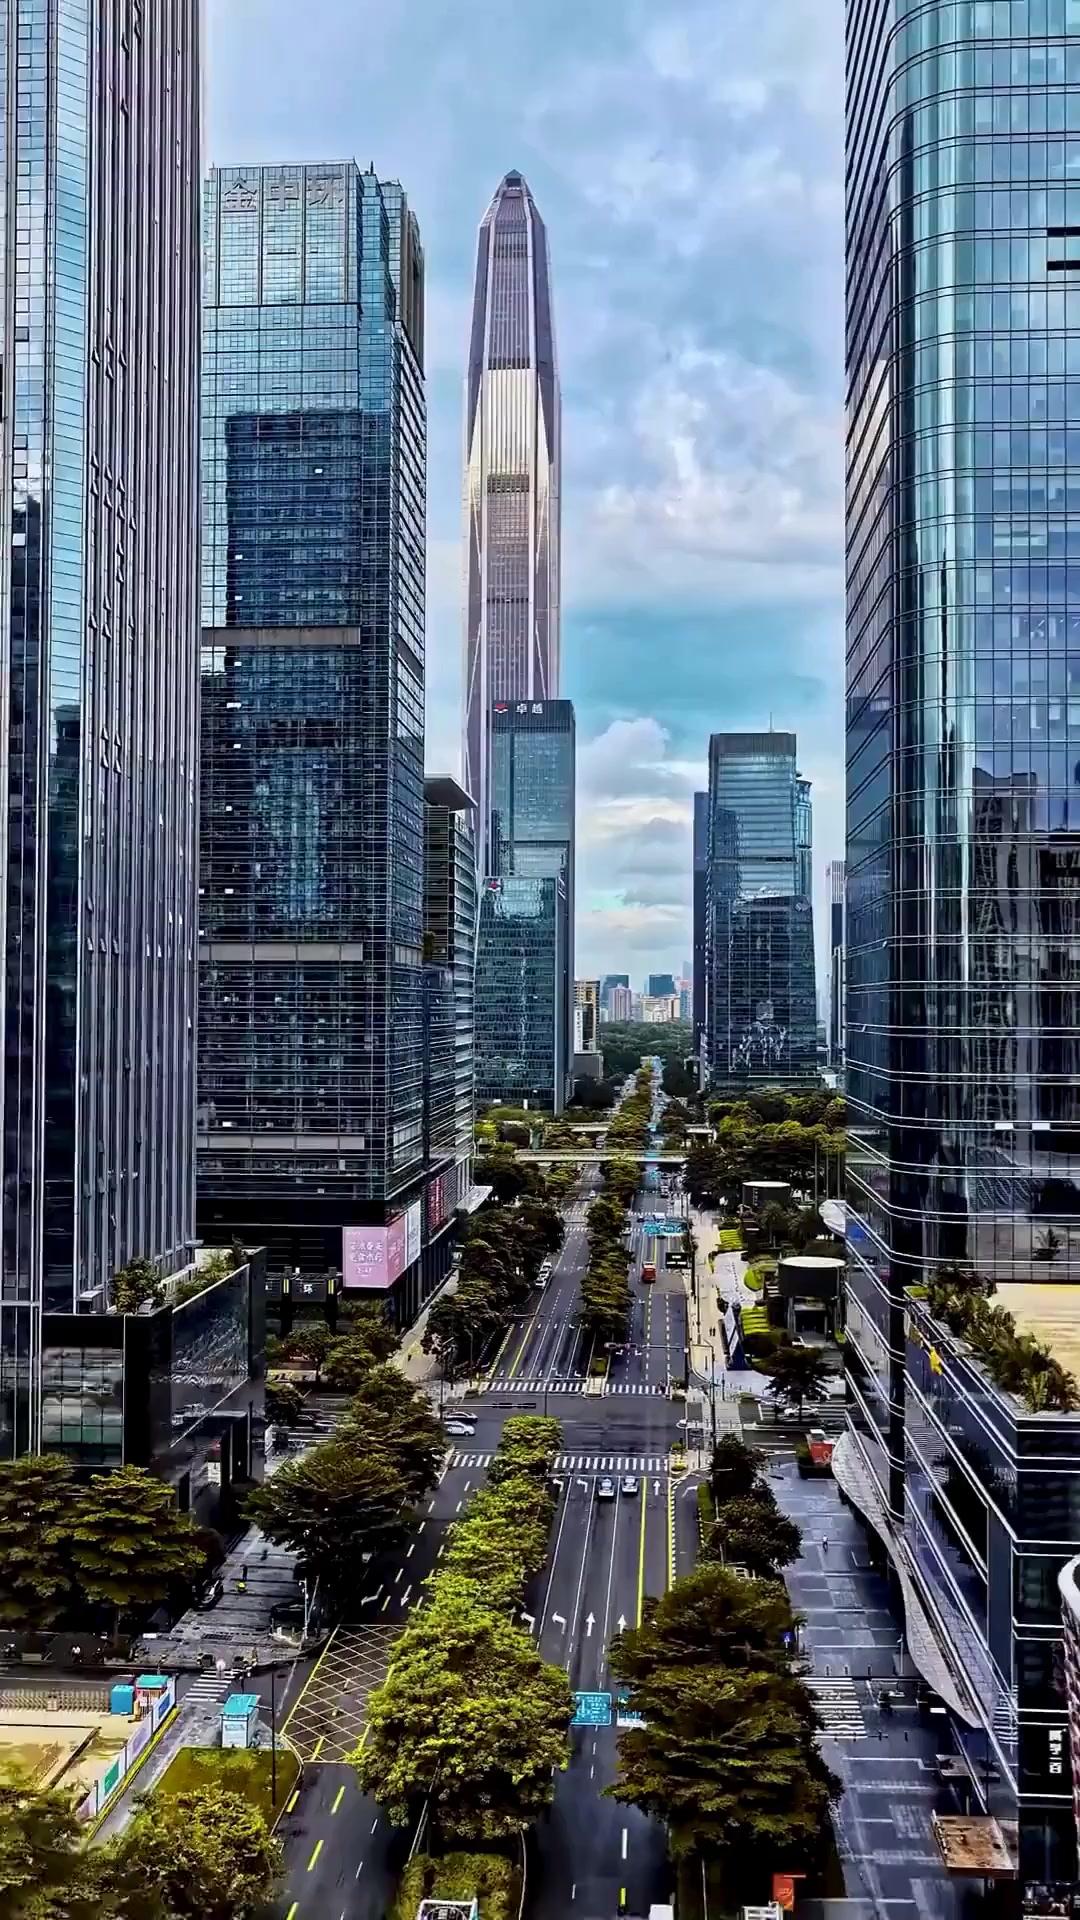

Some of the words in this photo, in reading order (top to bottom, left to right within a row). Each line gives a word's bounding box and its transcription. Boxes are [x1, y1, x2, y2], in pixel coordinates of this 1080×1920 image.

[222, 176, 344, 212] 金中环
[516, 703, 543, 714] 卓越
